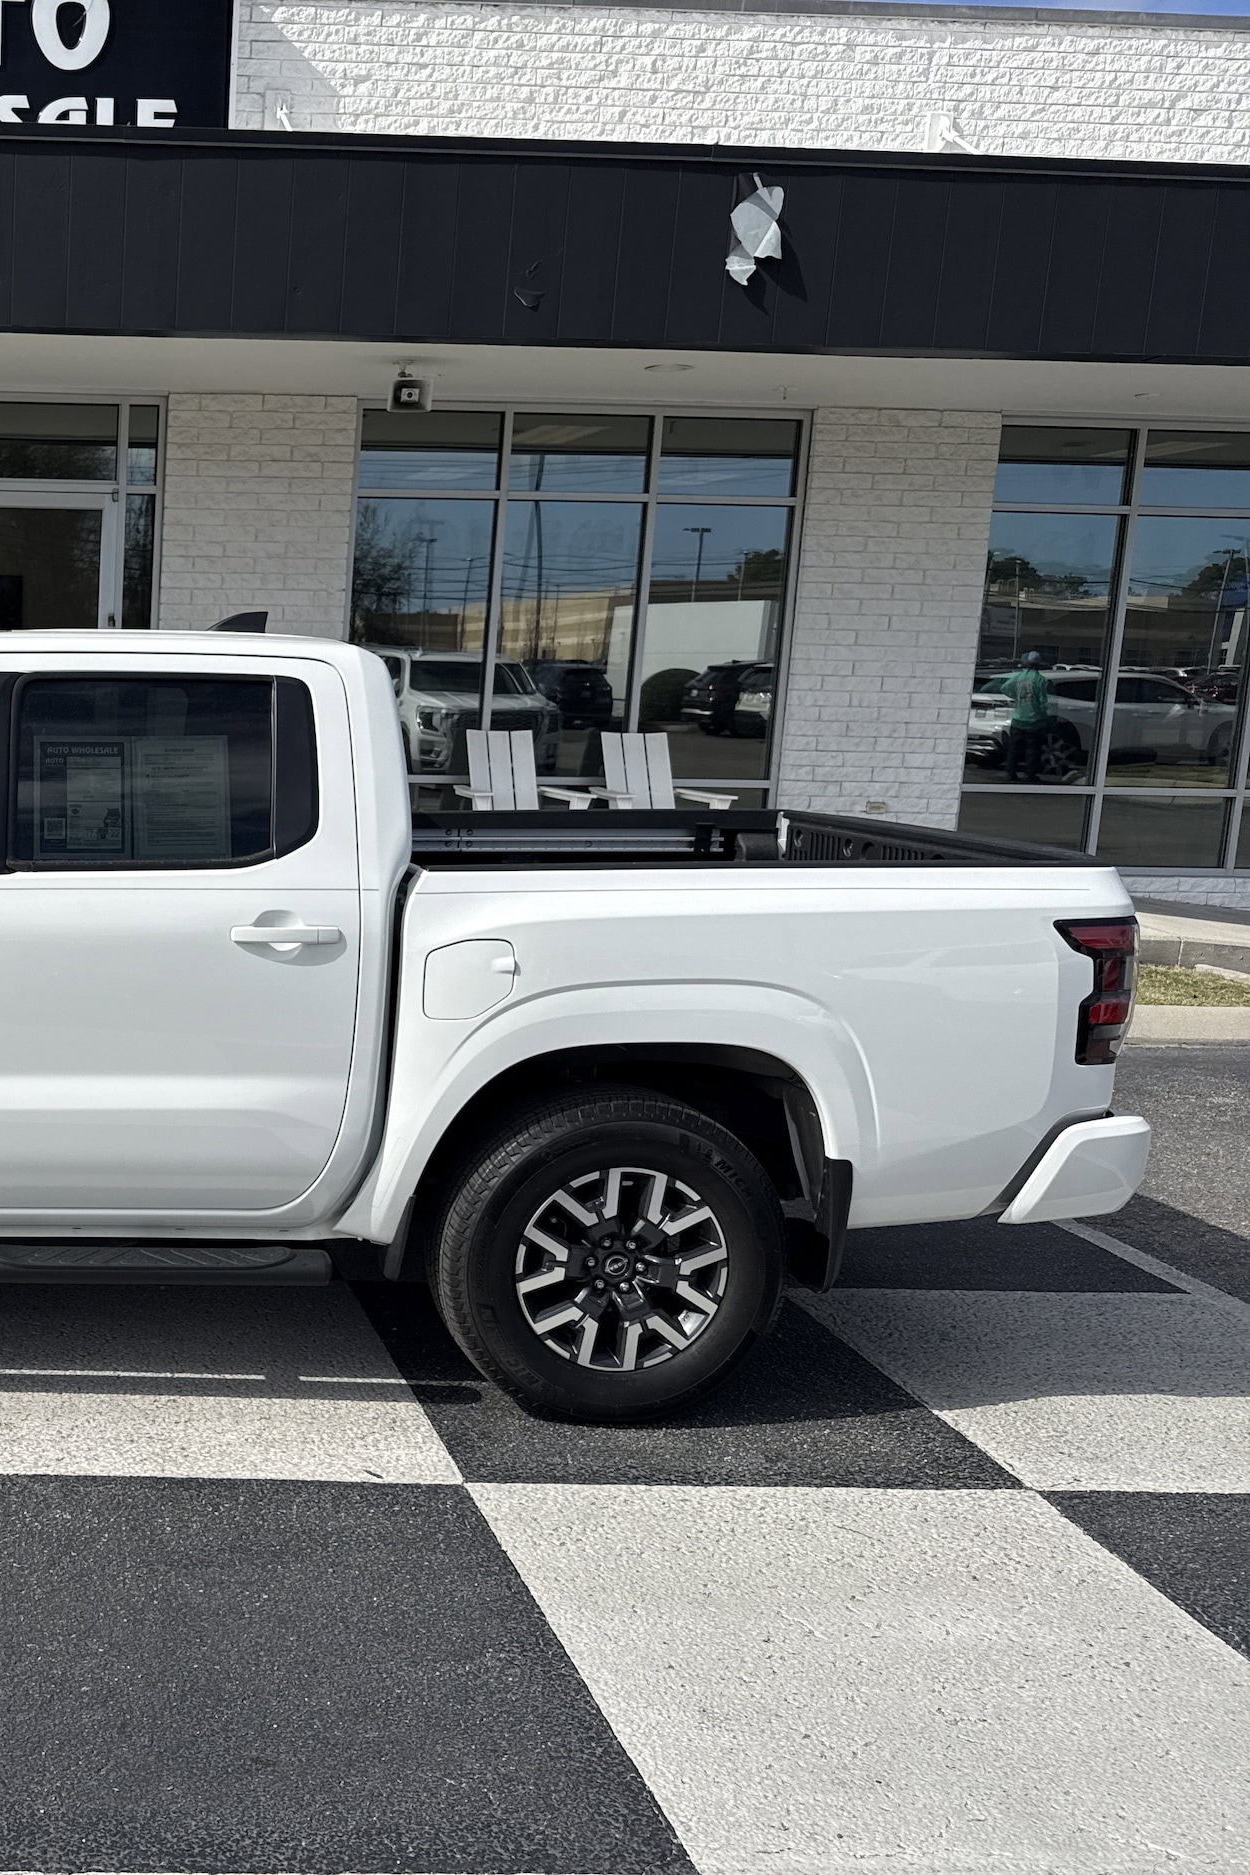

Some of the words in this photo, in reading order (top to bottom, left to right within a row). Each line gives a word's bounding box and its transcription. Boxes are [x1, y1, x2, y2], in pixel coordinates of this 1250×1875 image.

[46, 746, 69, 754] AUTO
[71, 746, 119, 754] WHOLESALE
[45, 757, 64, 765] AUTO
